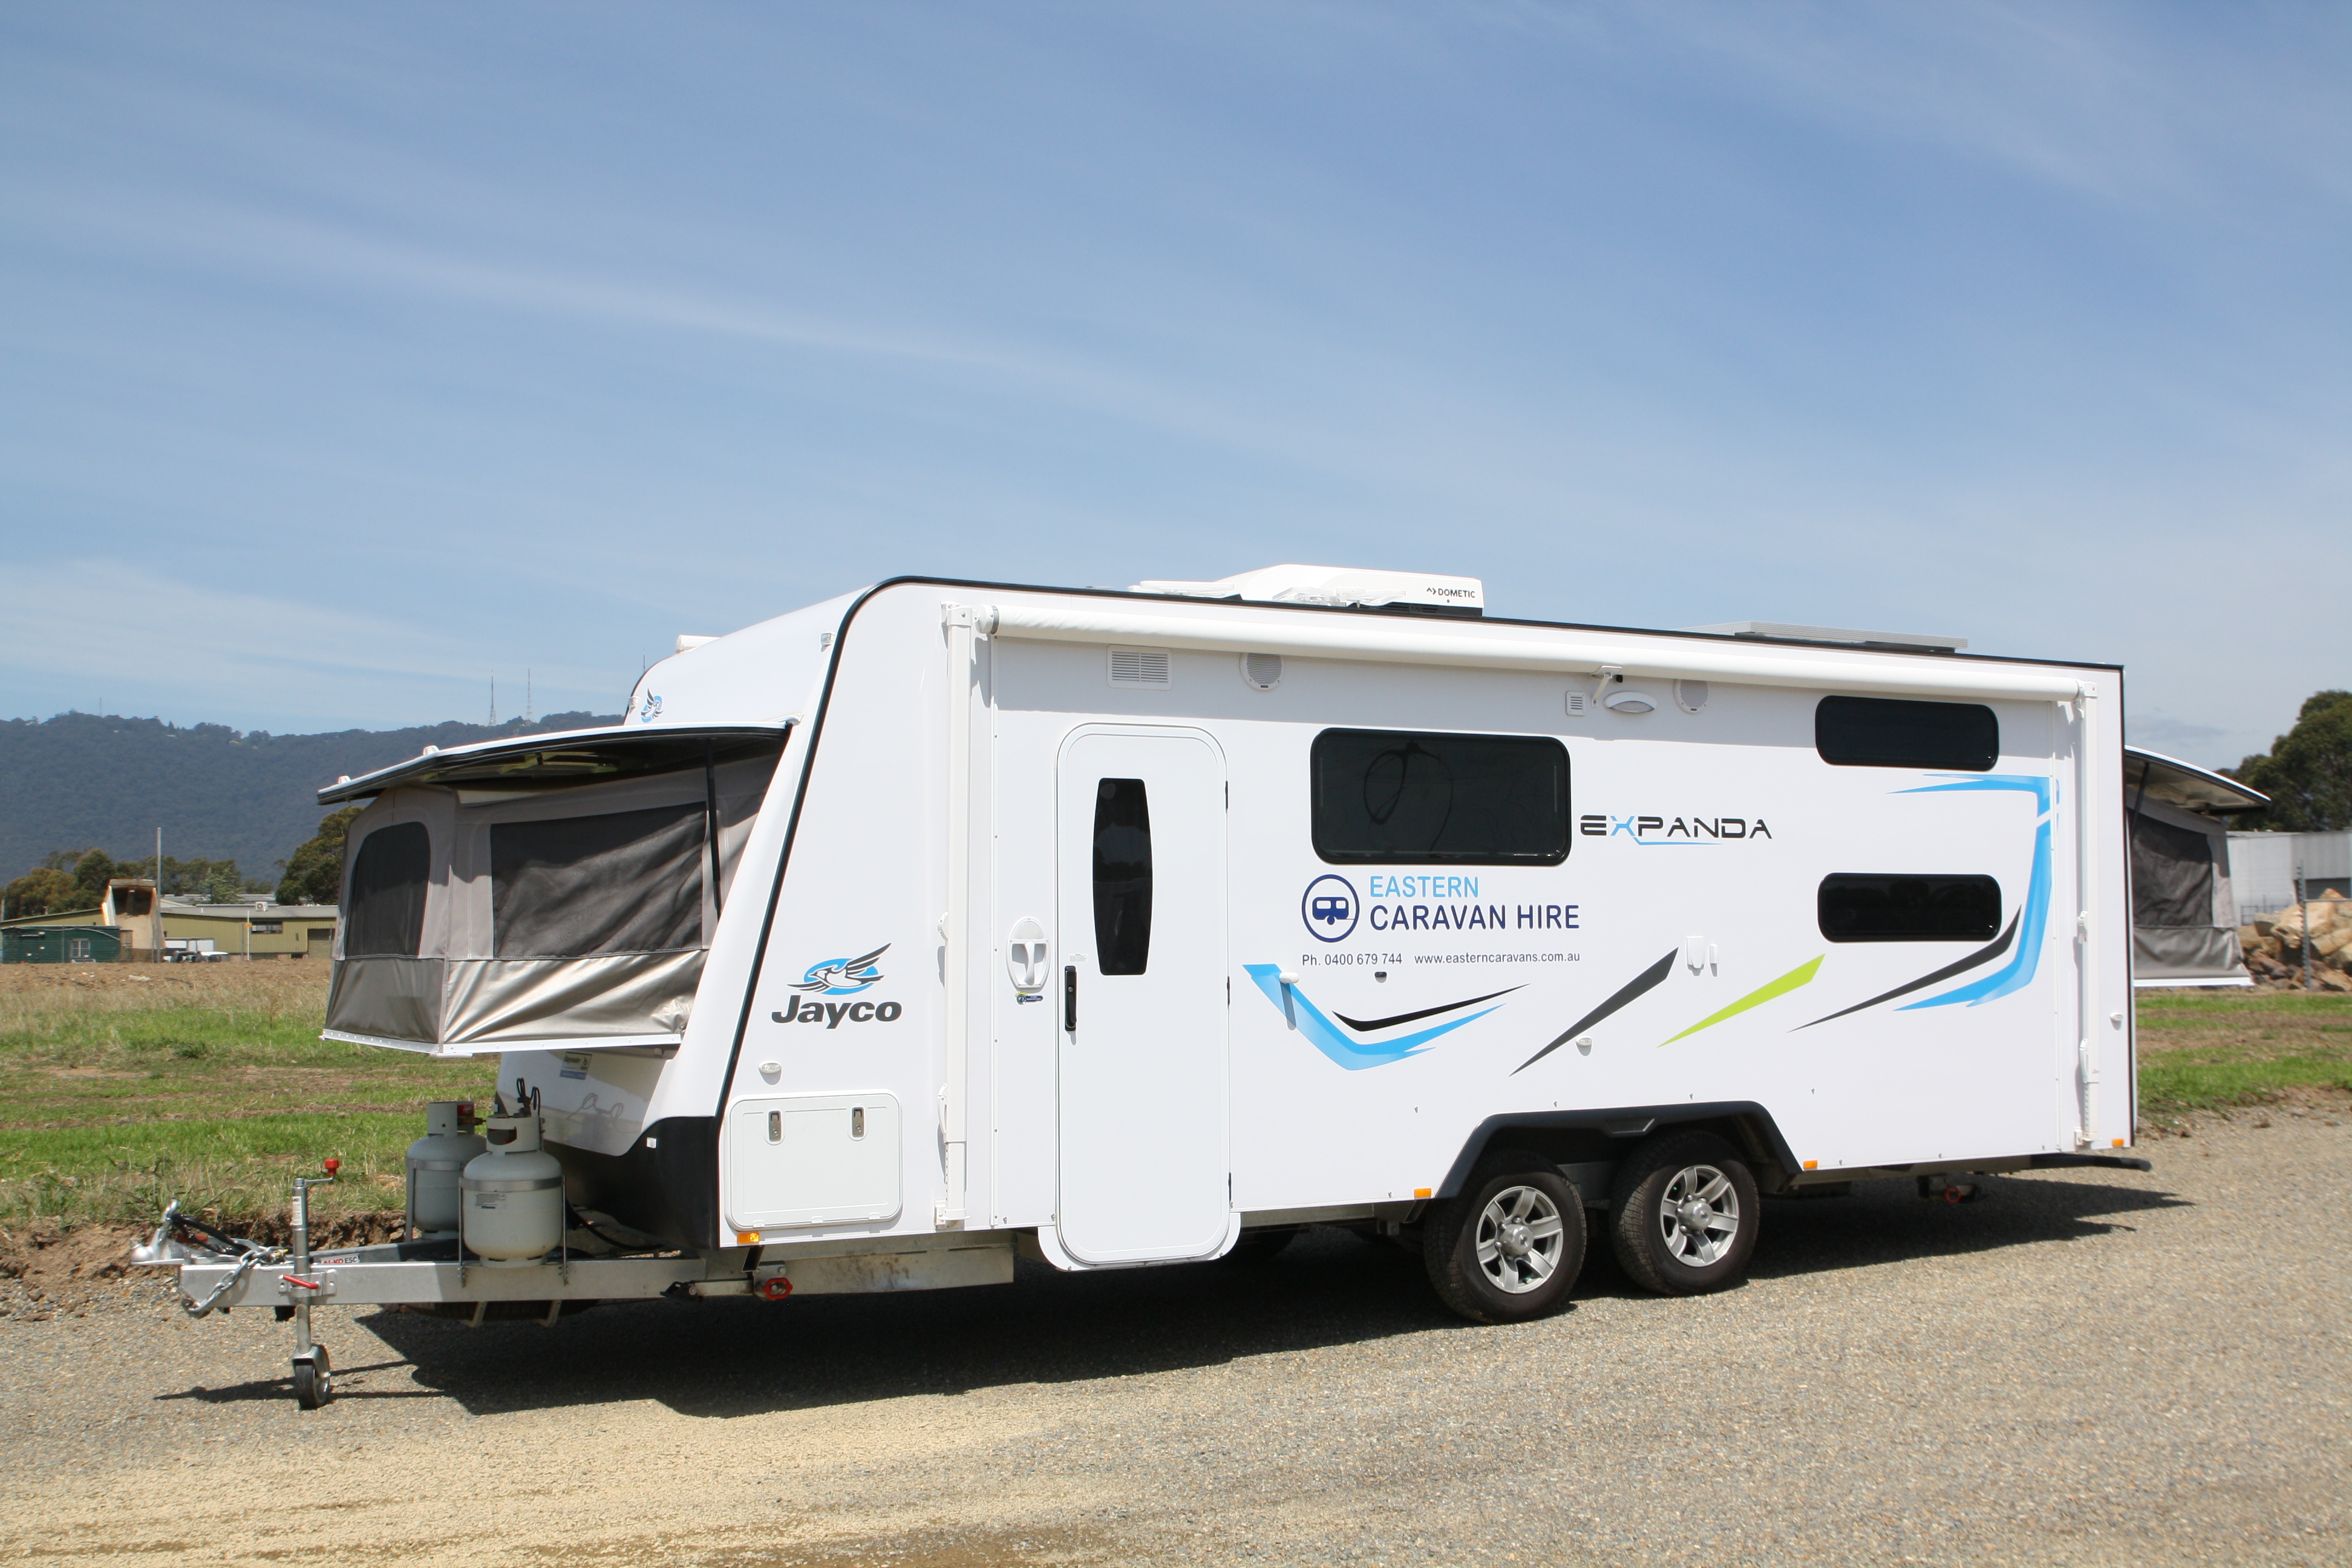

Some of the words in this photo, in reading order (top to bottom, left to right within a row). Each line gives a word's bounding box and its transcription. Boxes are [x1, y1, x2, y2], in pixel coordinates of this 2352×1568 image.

[1438, 588, 1475, 598] DOMETIC
[1580, 814, 1772, 839] EXPANDA
[1370, 875, 1478, 898] EASTERN
[1370, 904, 1506, 930] CARAVAN
[1517, 904, 1580, 929] HIRE
[1302, 954, 1321, 966] Ph.
[1324, 953, 1353, 965] 0400
[1357, 953, 1378, 965] 679
[1382, 953, 1402, 964] 744
[1414, 952, 1580, 964] www.easterncaravans.com.au
[771, 994, 902, 1030] Jayco
